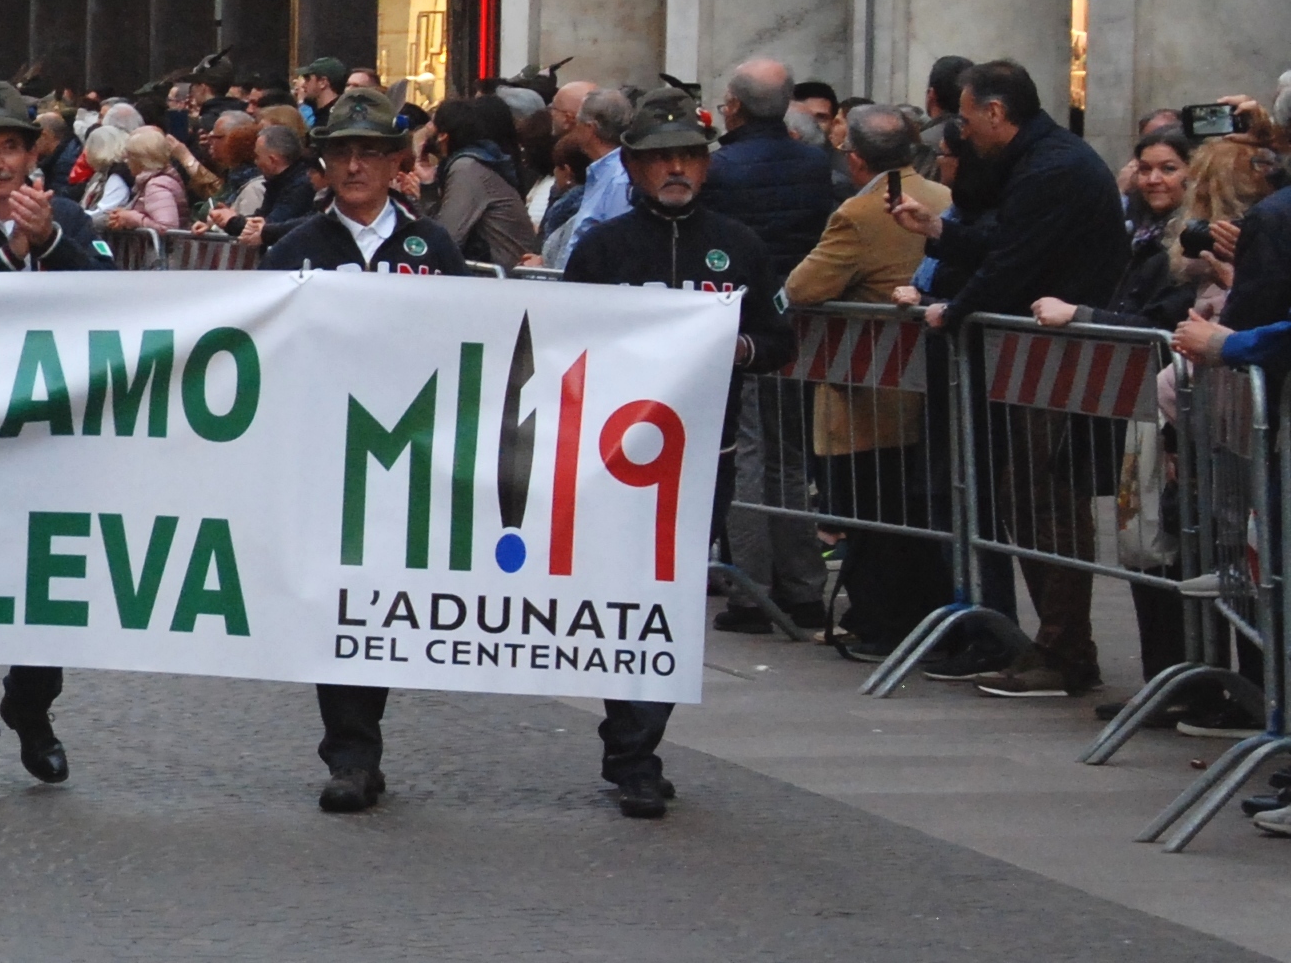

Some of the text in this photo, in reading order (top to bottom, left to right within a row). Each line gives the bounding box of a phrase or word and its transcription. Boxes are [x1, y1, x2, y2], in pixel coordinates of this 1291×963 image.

[337, 587, 673, 643] L'ADUNATA
[335, 634, 676, 677] DEL CENTENARIO
